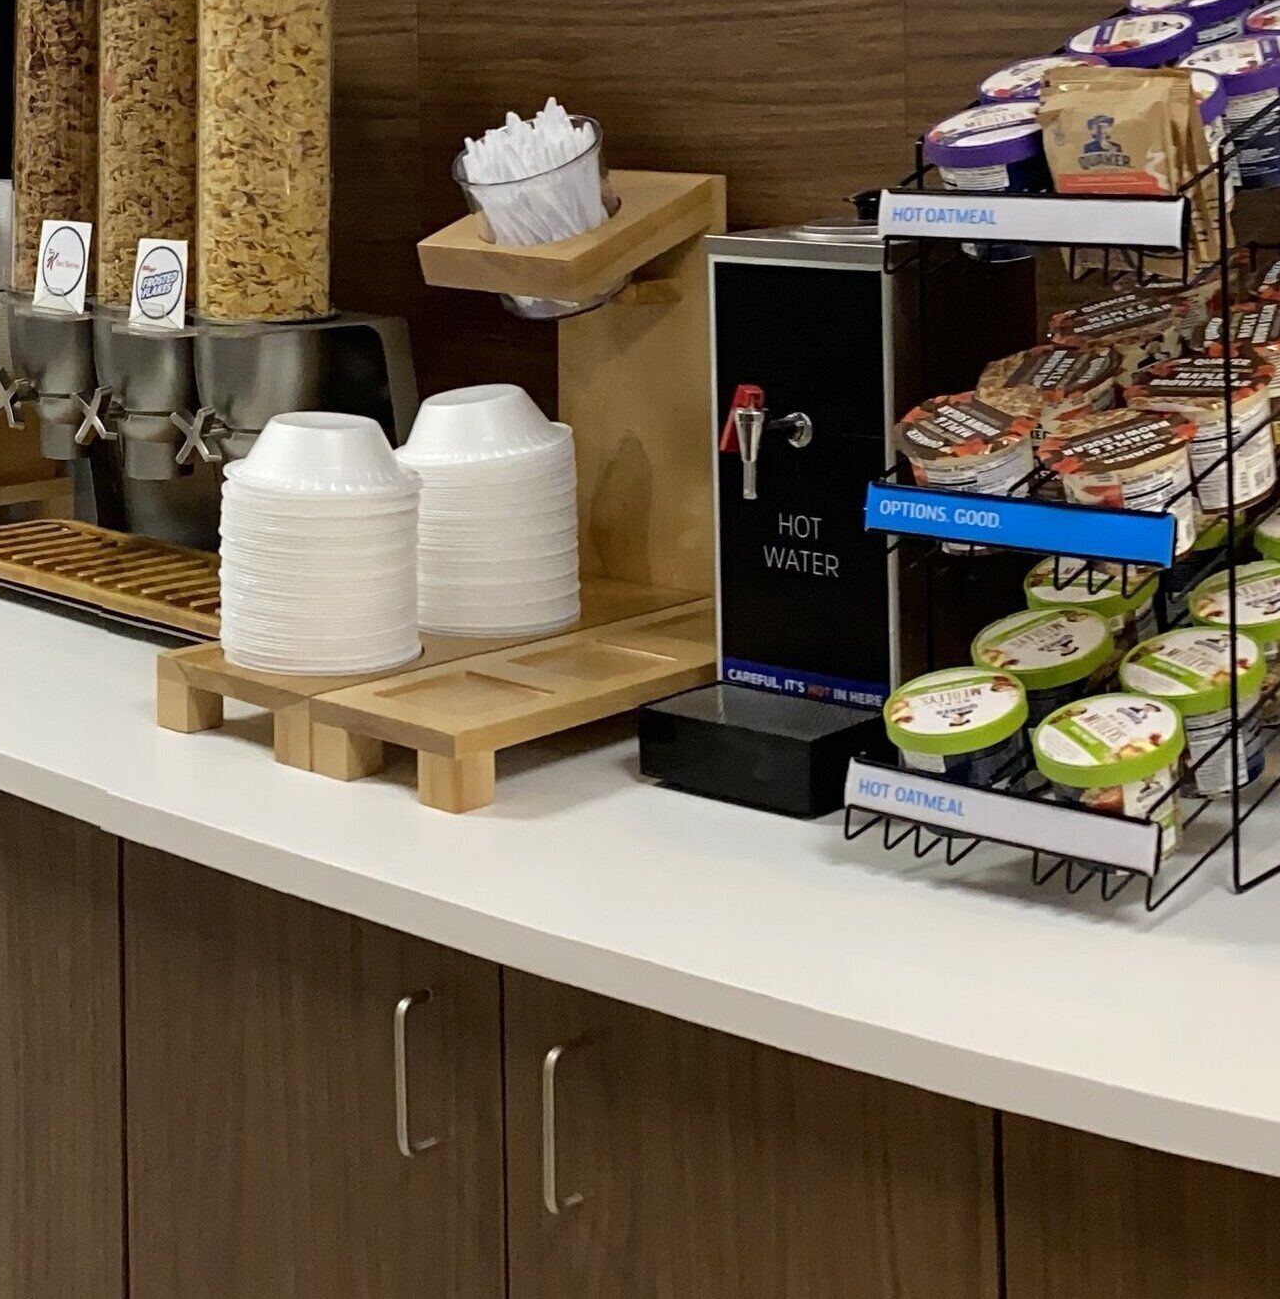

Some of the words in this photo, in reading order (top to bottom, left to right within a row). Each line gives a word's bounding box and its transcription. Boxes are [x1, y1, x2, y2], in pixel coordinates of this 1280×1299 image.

[1077, 154, 1132, 169] QUAKER
[892, 207, 923, 223] HOT
[924, 207, 998, 225] OATMEAL
[1113, 420, 1171, 440] BROWN
[1061, 437, 1113, 456] SUGAR
[1102, 432, 1156, 452] MAPLE
[879, 499, 949, 523] OPTIONS.
[778, 512, 822, 541] HOT
[763, 545, 840, 578] WATER
[727, 668, 783, 690] CAREFUL,
[784, 679, 805, 694] IT'S
[833, 688, 848, 701] IN
[849, 691, 883, 707] HERE
[858, 778, 889, 798] HOT
[894, 787, 966, 816] OATMEAL
